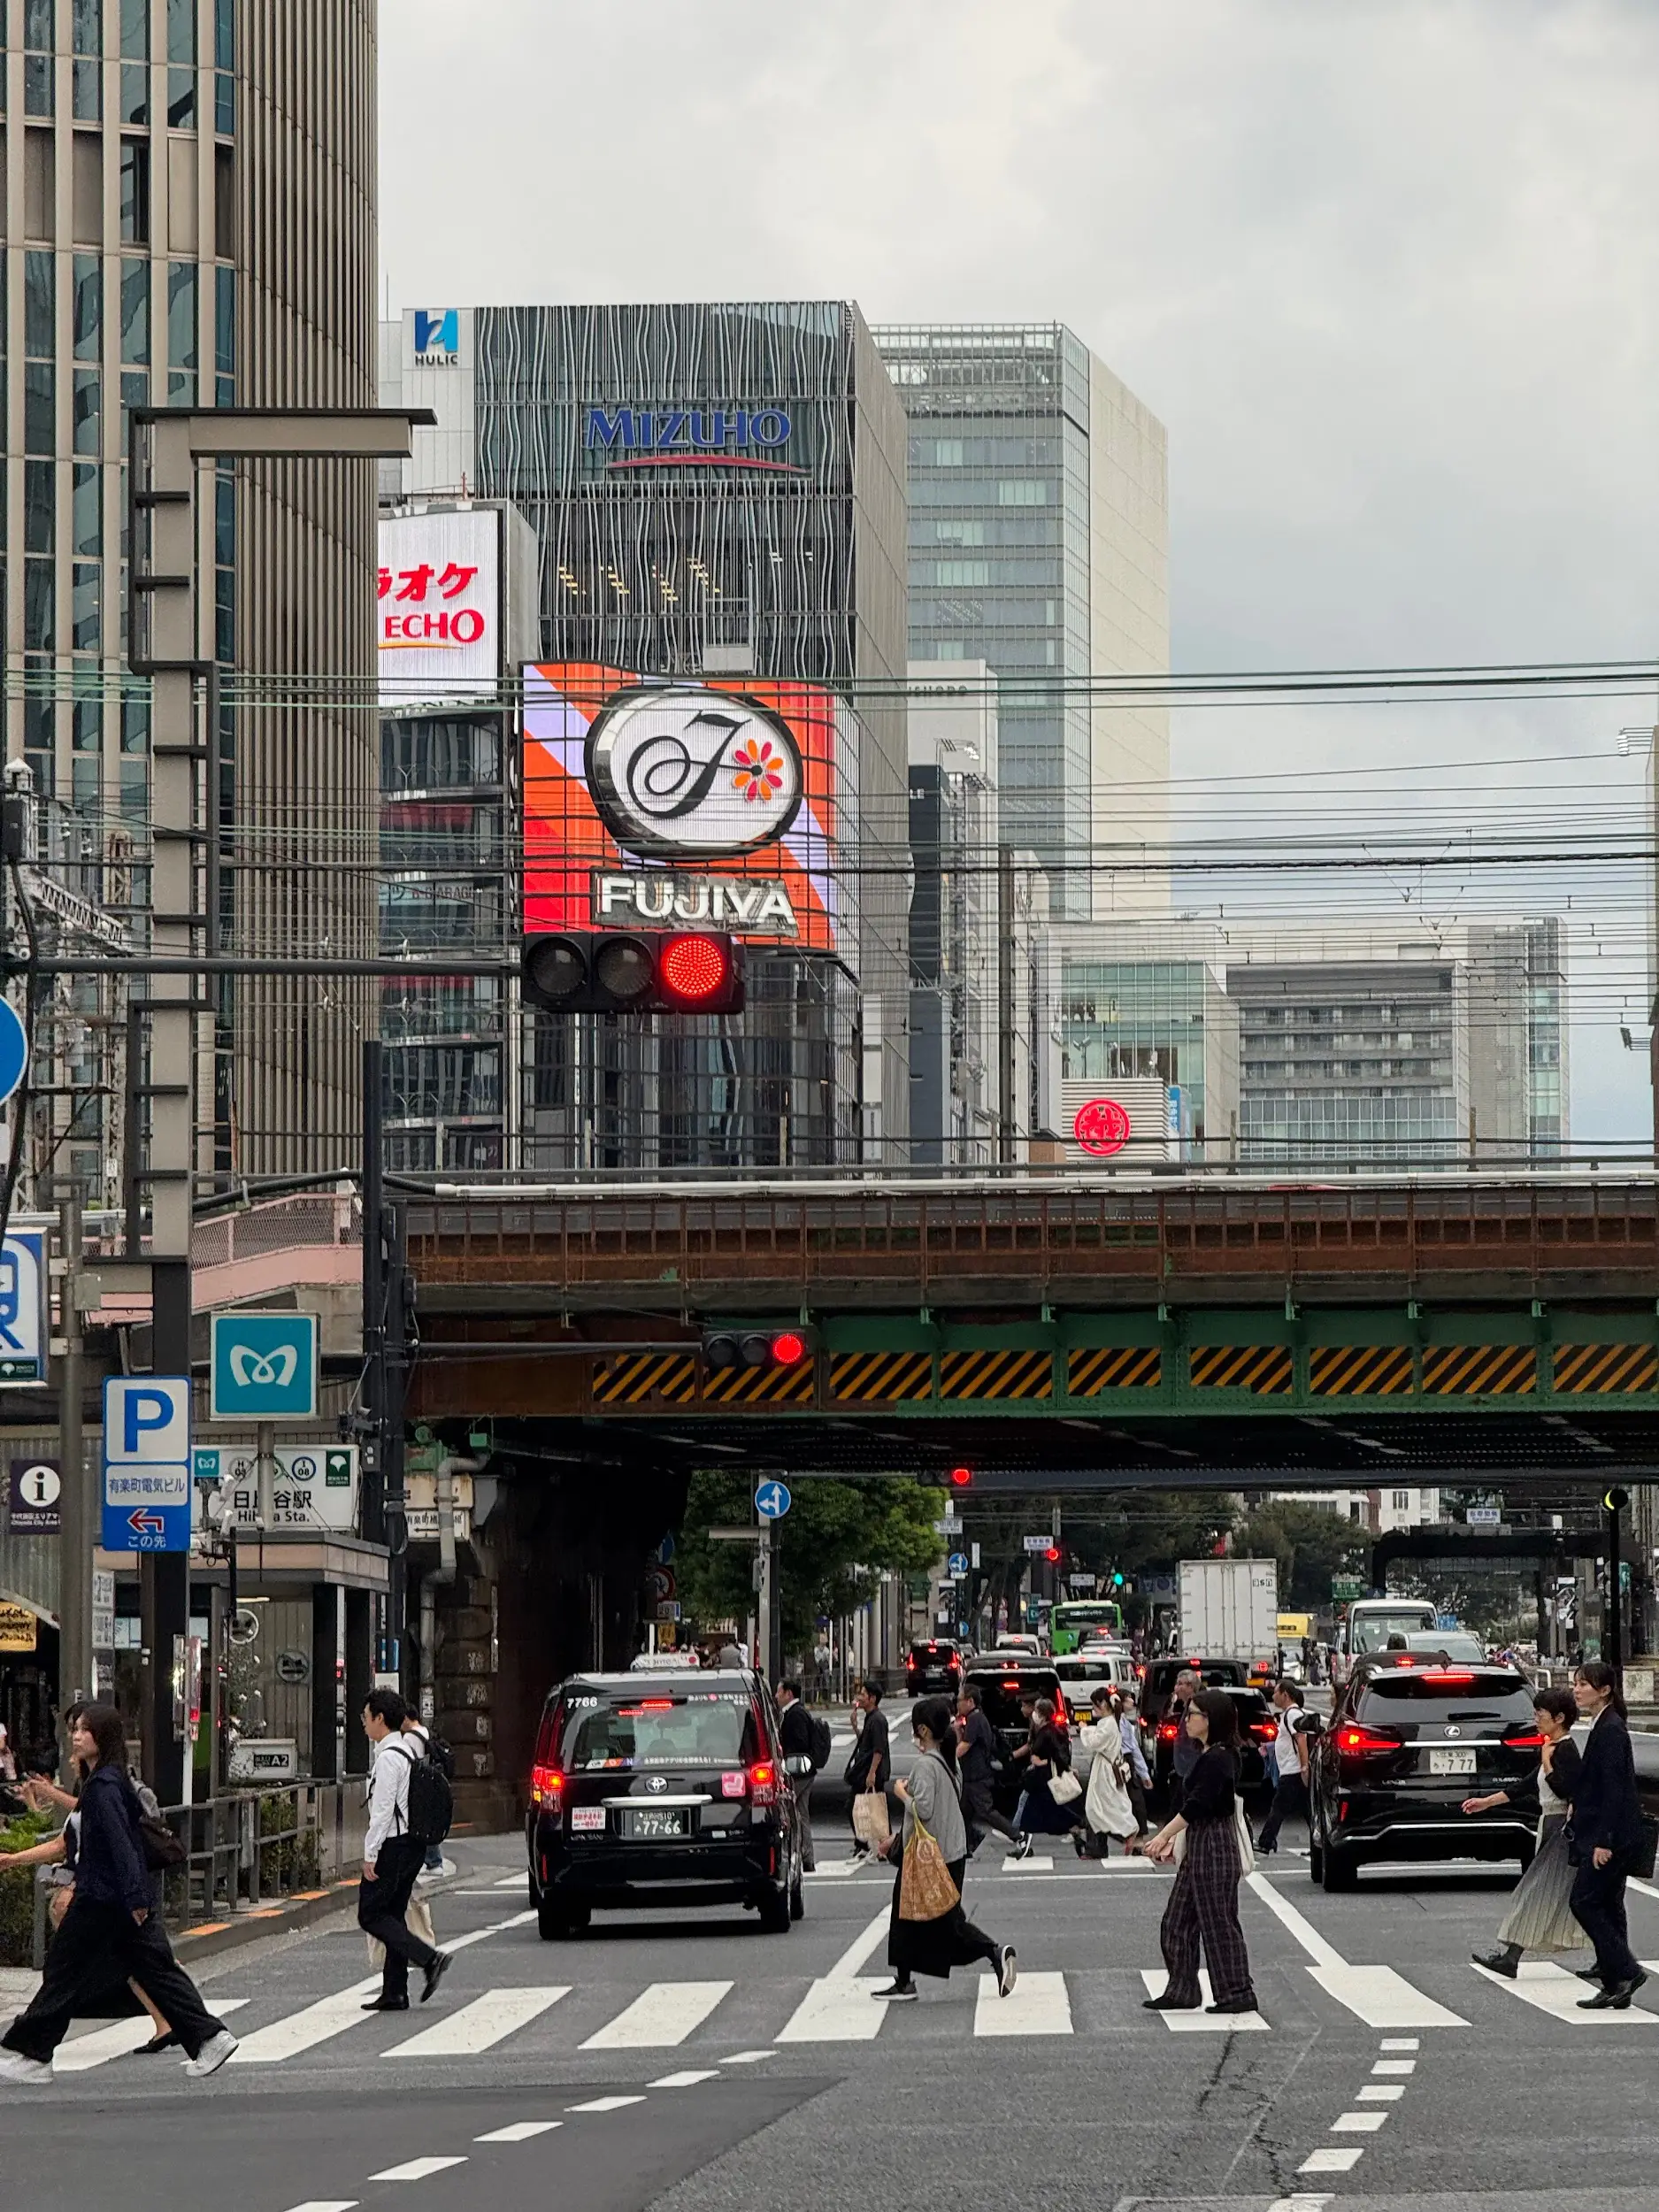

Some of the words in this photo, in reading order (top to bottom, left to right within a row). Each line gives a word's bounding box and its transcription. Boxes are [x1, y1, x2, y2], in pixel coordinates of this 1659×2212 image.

[415, 355, 458, 366] HULIC
[587, 408, 792, 449] MIZUHO
[385, 609, 485, 643] ECHO
[597, 876, 796, 925] FUJIYA
[124, 1389, 174, 1452] P
[109, 1478, 185, 1494] 有楽町電気ビル
[285, 1511, 310, 1523] Sta.
[127, 1535, 166, 1548] この先
[567, 1696, 598, 1709] 7766
[271, 1755, 288, 1767] A2
[642, 1819, 681, 1836] 77-66
